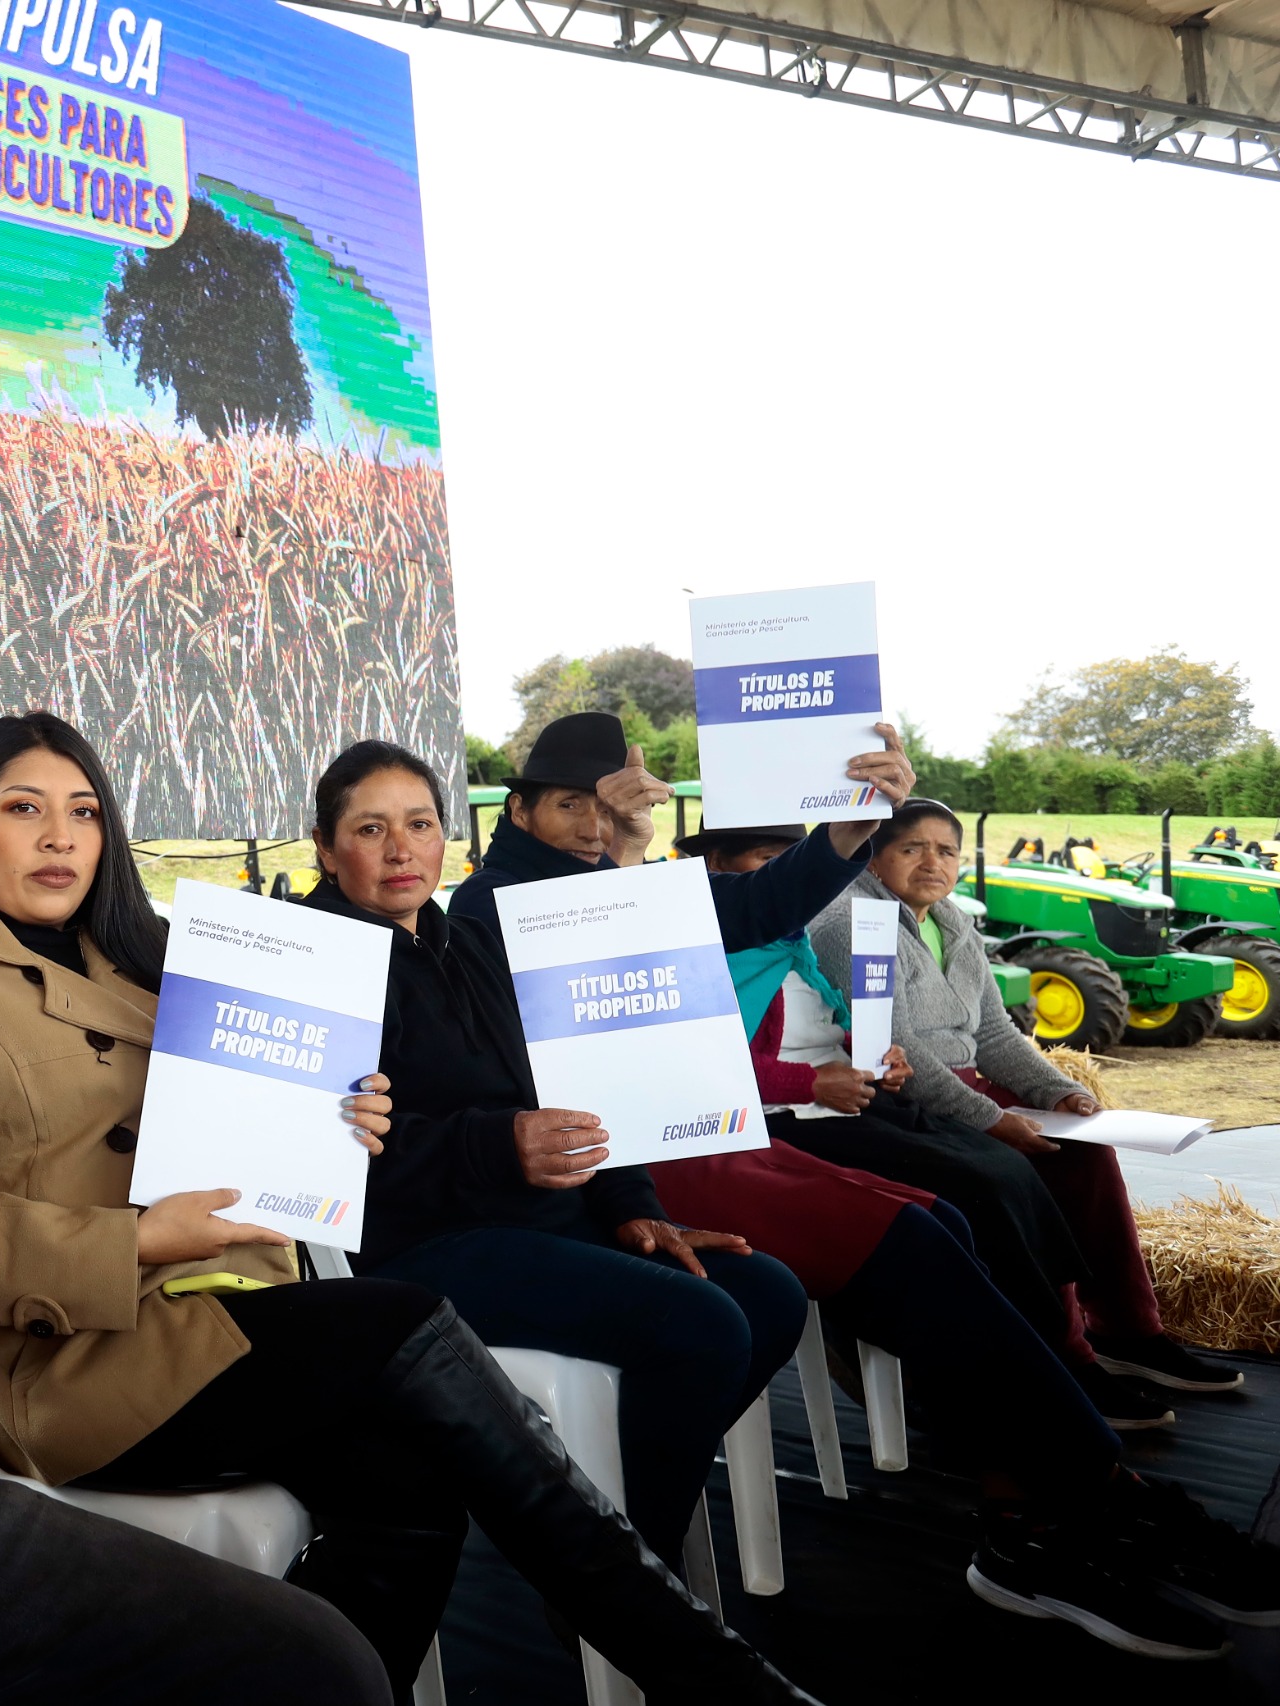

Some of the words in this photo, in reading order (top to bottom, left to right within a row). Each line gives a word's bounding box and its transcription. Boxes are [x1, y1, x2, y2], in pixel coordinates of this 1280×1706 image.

[60, 93, 147, 167] PARA
[705, 620, 746, 630] Ministerio
[761, 616, 810, 626] Agricultura,
[759, 625, 784, 633] Pesca
[739, 672, 809, 694] TÍTULOS
[812, 670, 835, 688] DE
[740, 689, 835, 713] PROPIEDAD
[799, 794, 851, 810] ECUADOR
[517, 911, 565, 925] Ministerio
[567, 909, 579, 917] de
[581, 901, 638, 915] Agricultura,
[580, 914, 609, 924] Pesca
[189, 917, 240, 935] Ministerio
[241, 929, 255, 939] de
[256, 933, 315, 955] Agricultura,
[243, 940, 251, 949] y
[252, 941, 283, 956] Pesca
[568, 969, 649, 999] TÍTULOS
[652, 965, 678, 988] DE
[573, 989, 681, 1023] PROPIEDAD
[215, 1000, 300, 1041] TÍTULOS
[301, 1022, 330, 1048] DE
[210, 1028, 324, 1074] PROPIEDAD
[662, 1119, 720, 1141] ECUADOR
[697, 1114, 704, 1122] EL
[254, 1192, 319, 1220] ECUADOR
[296, 1192, 304, 1200] EL
[305, 1193, 323, 1204] NUEVO
